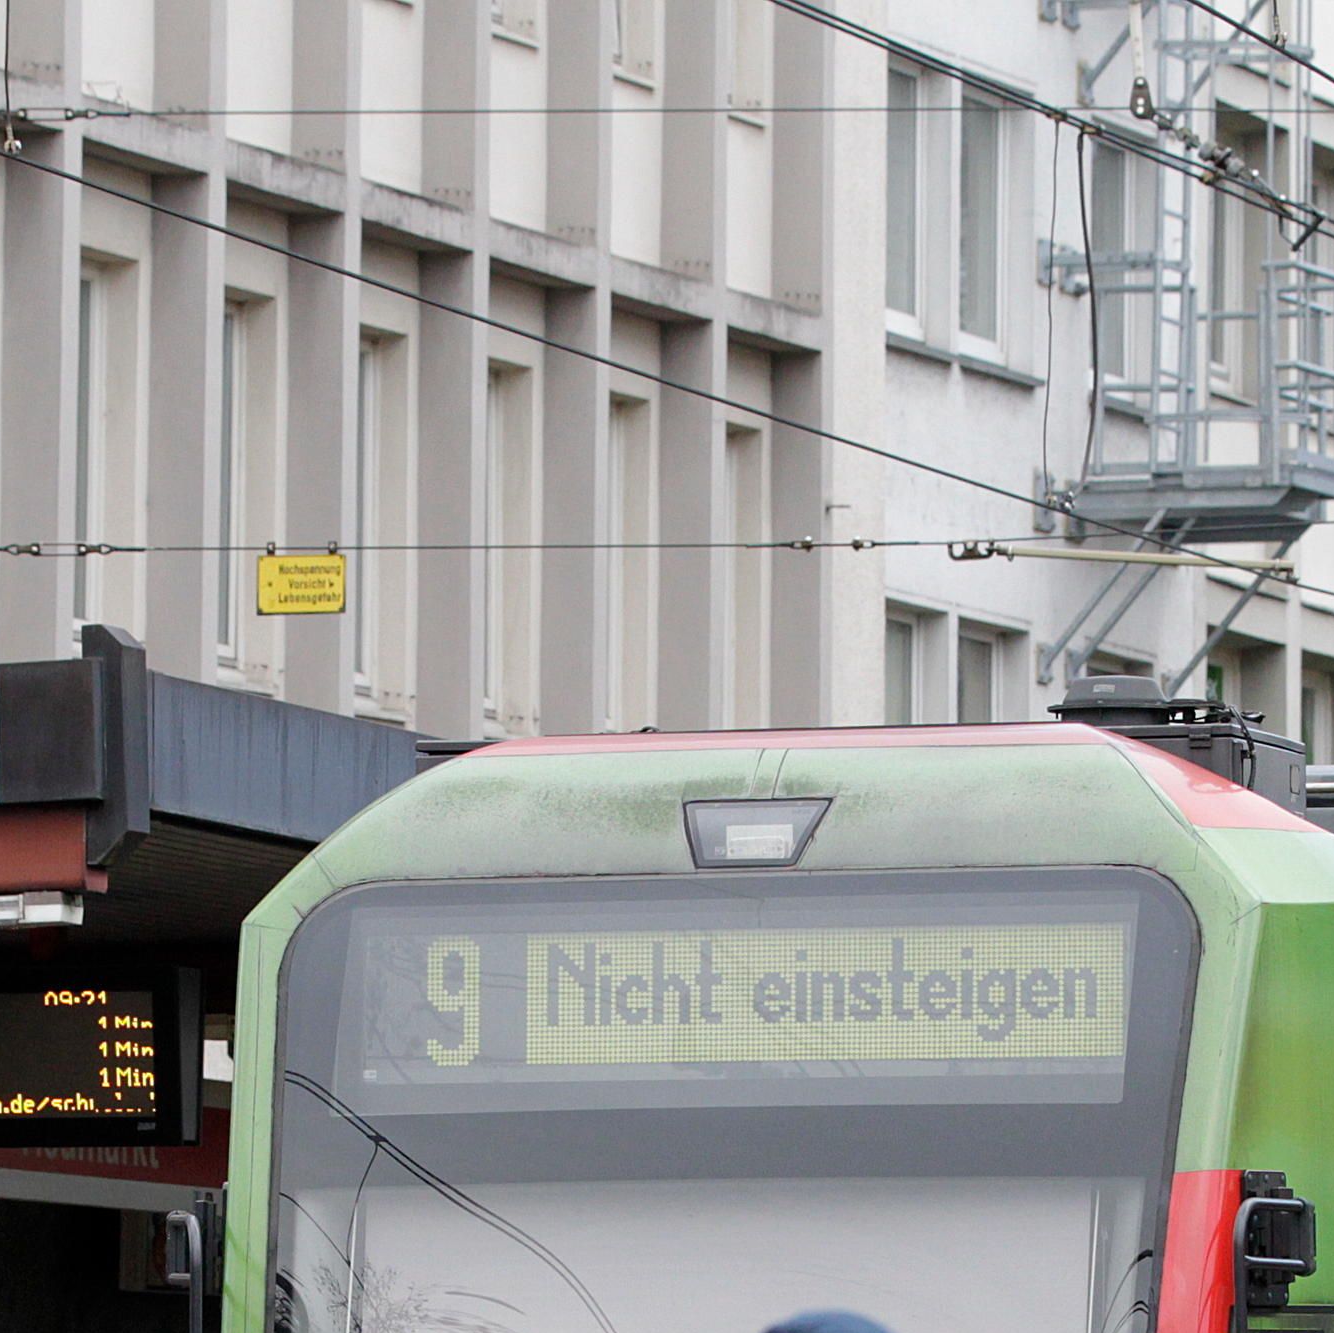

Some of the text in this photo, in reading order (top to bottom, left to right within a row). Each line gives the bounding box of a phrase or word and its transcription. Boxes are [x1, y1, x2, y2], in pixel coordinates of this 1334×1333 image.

[426, 936, 1098, 1066] 9 Nicht einsteigen
[98, 1041, 108, 1057] 1
[114, 1040, 155, 1057] Min
[99, 1067, 110, 1088] 1
[115, 1066, 155, 1088] Min
